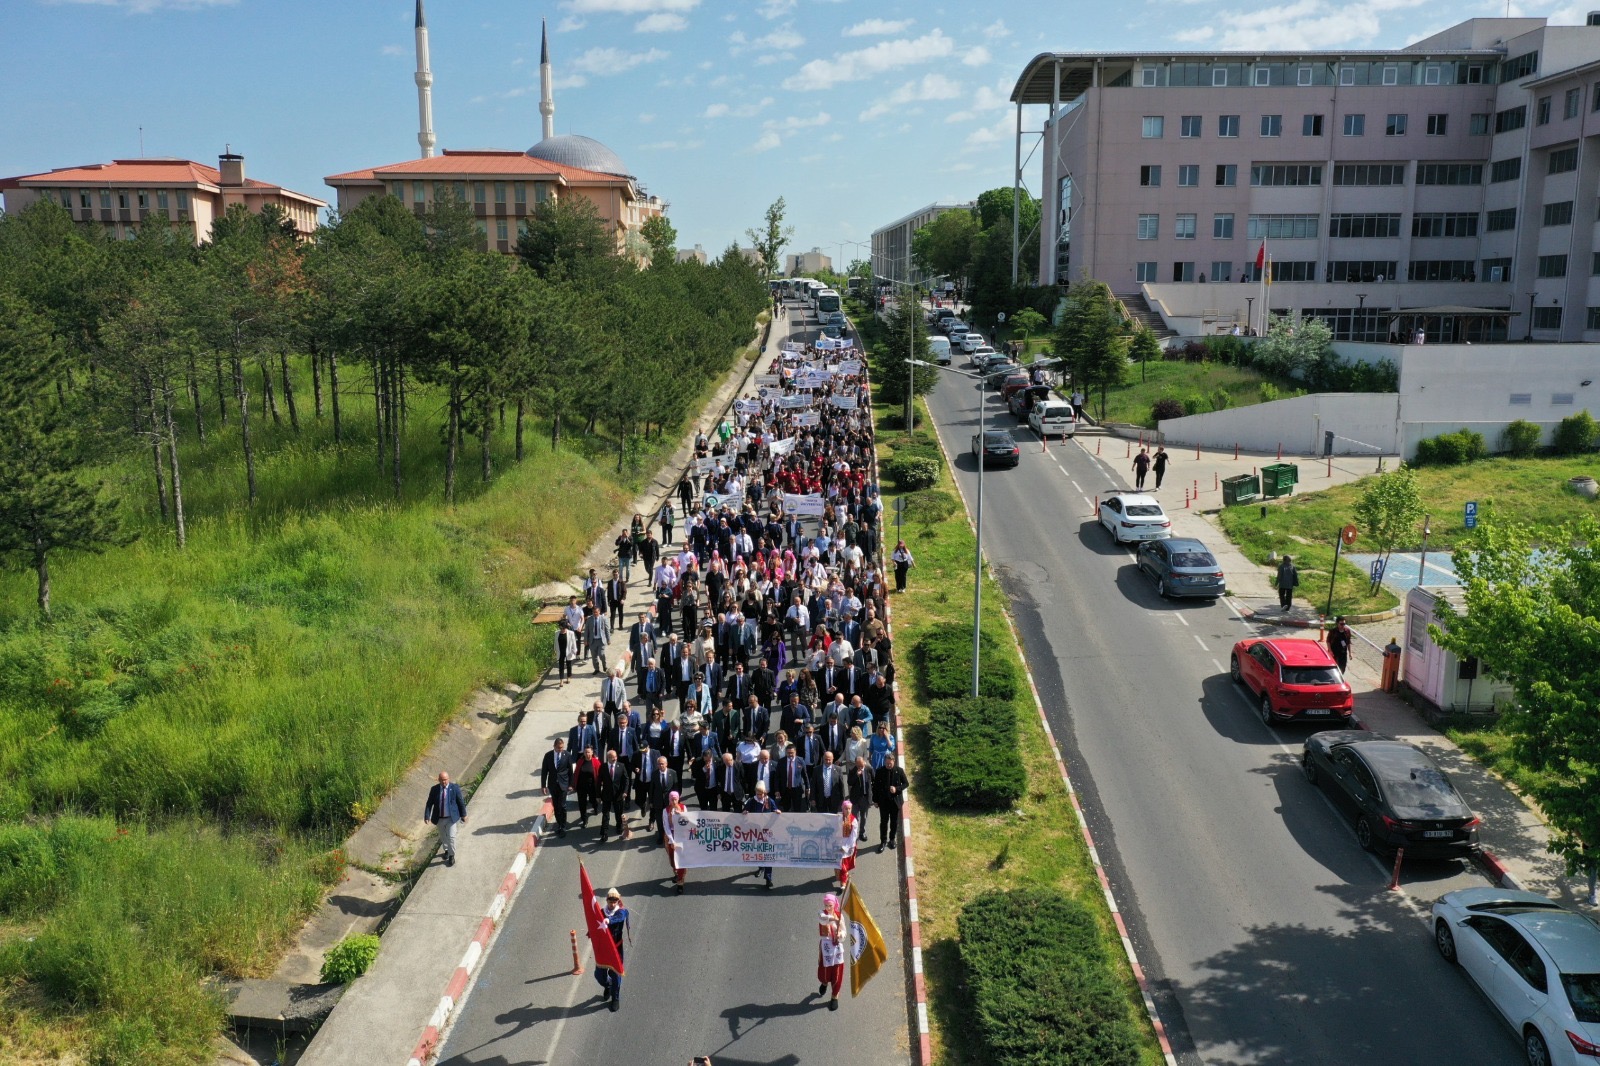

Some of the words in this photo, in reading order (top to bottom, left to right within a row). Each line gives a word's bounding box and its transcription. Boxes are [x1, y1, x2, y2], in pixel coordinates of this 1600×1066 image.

[1467, 504, 1474, 513] P
[696, 818, 706, 828] 38
[706, 840, 740, 852] SPOR
[741, 853, 764, 861] 12-15
